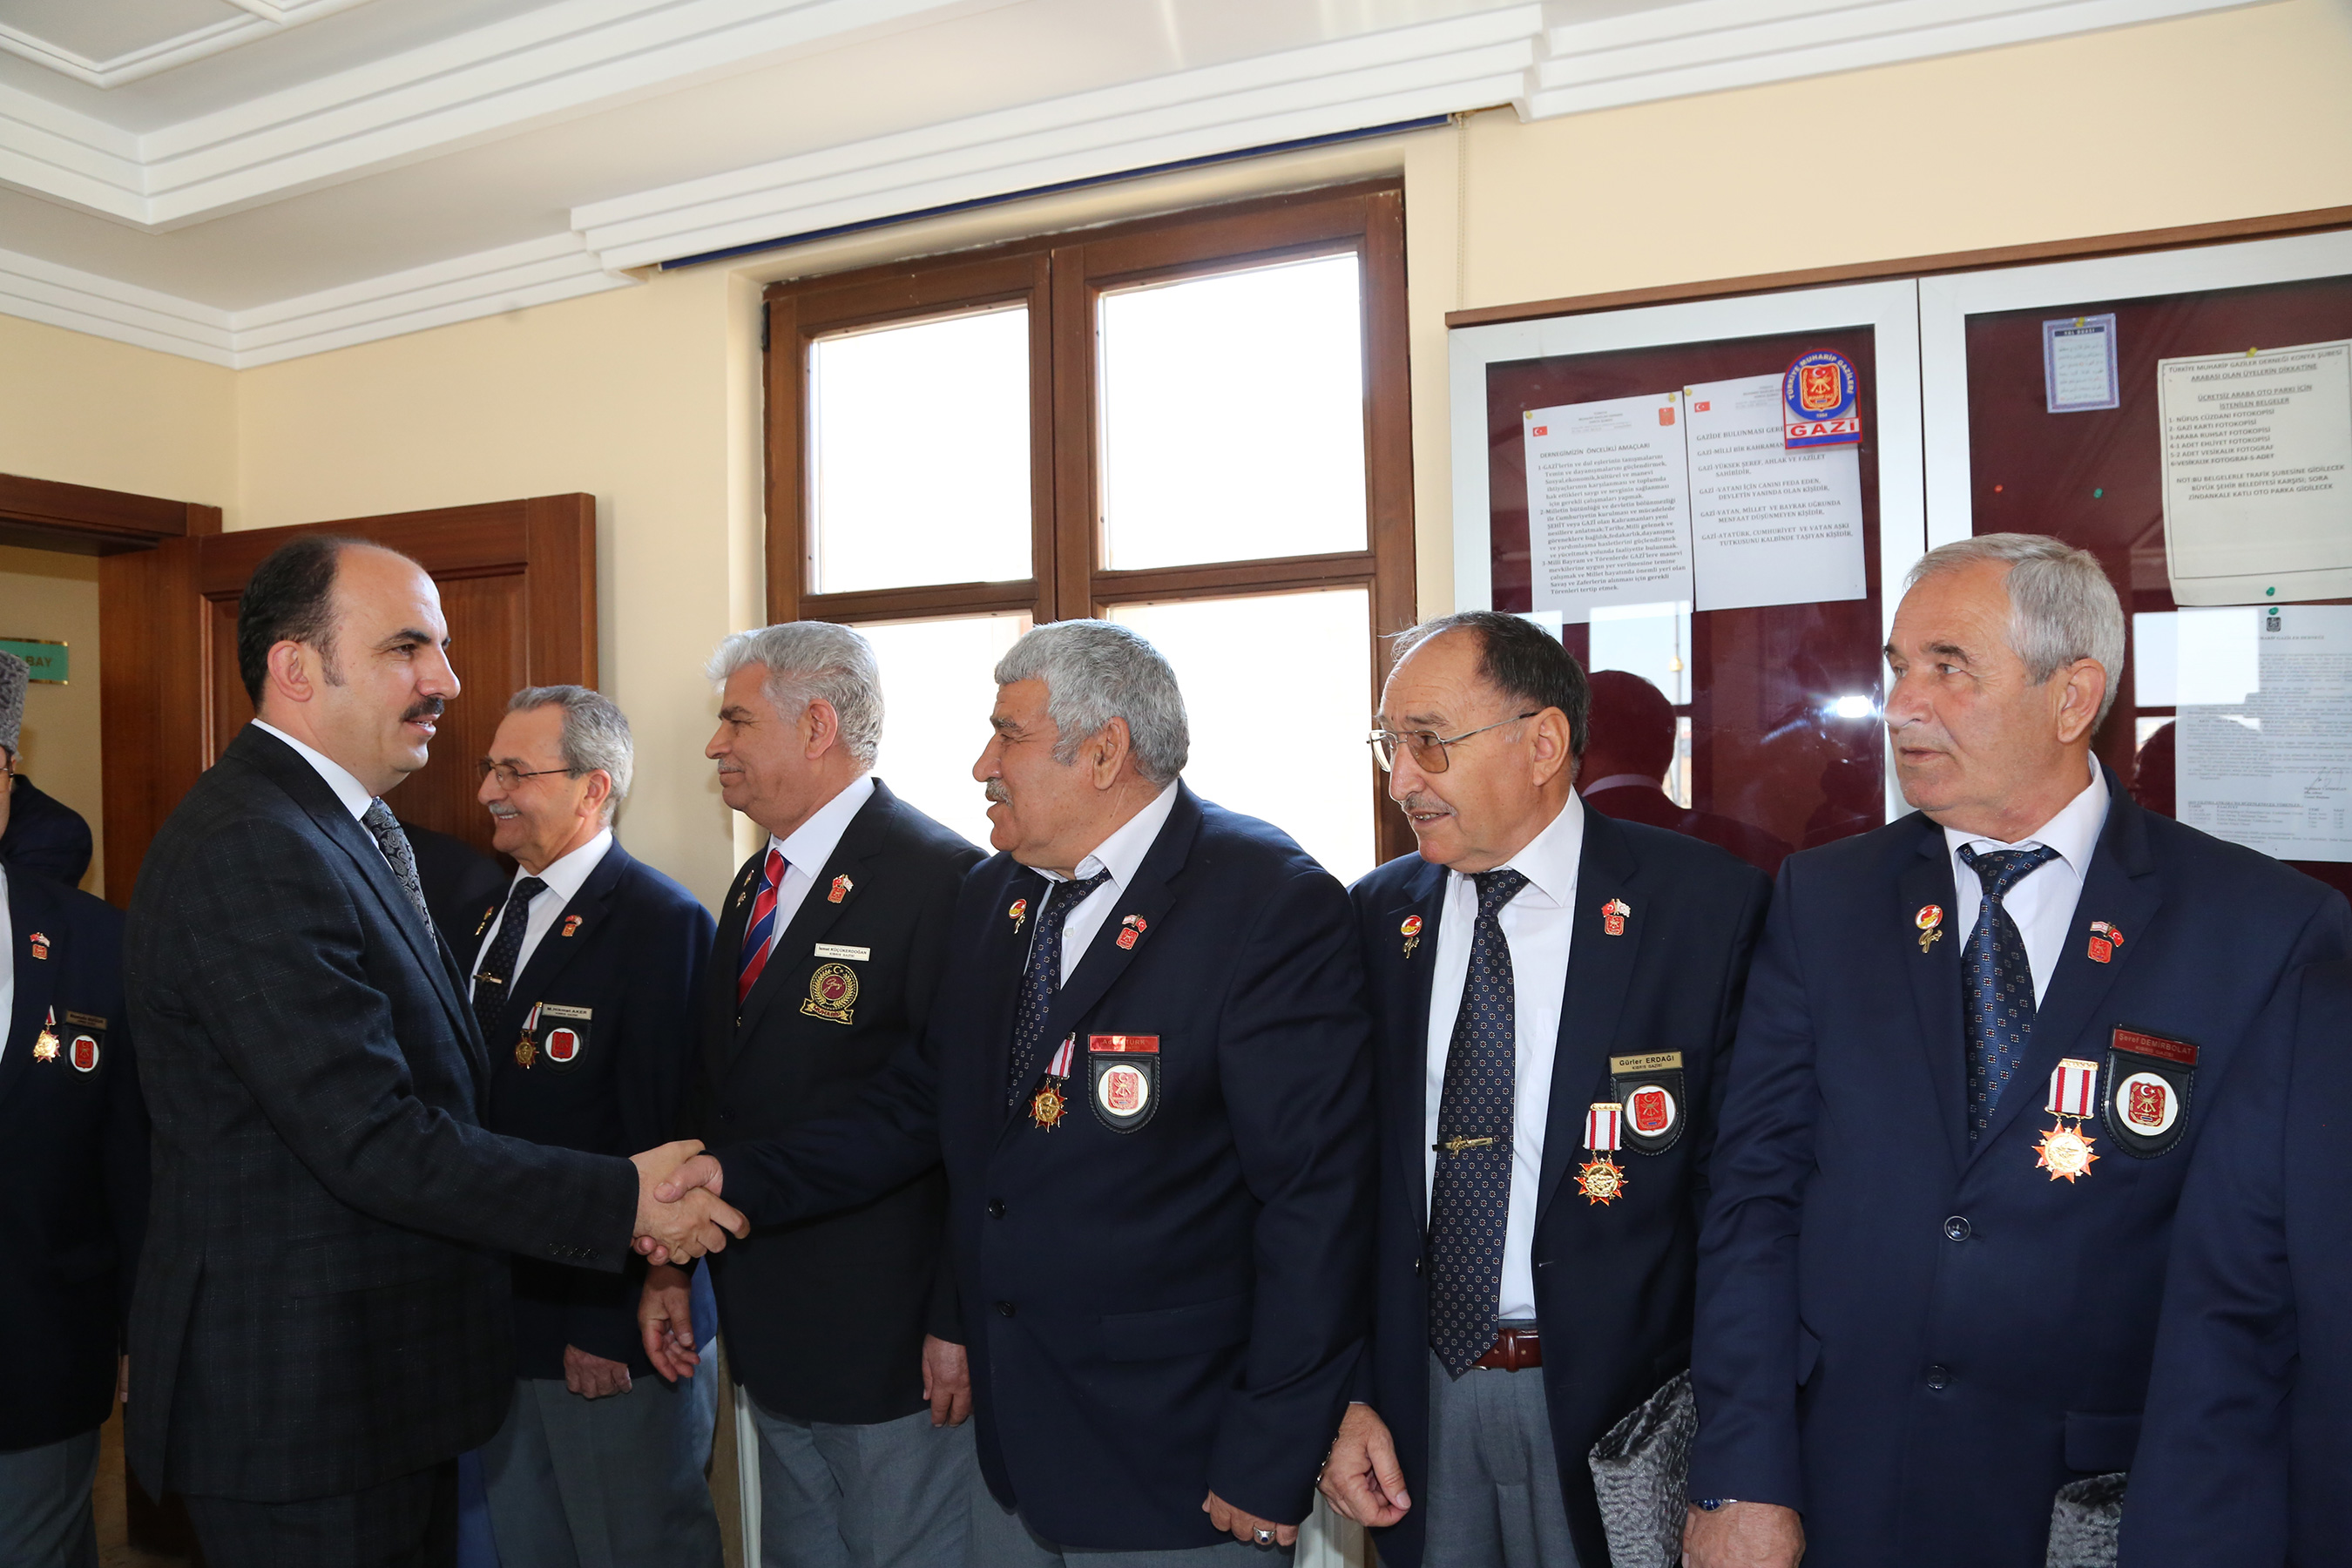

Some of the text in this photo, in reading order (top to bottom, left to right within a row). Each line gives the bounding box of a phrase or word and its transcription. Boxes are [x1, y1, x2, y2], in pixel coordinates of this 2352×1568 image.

[2168, 348, 2342, 374] TÜRKİYE MUHARİP GAZİLER DERNEĞİ KONYA ŞUBESİ
[1786, 363, 1801, 401] TÜRKİYE
[1799, 353, 1838, 368] MUHARİP
[1836, 359, 1855, 395] GAZİLERİ
[2190, 373, 2220, 382] ARABASI
[2242, 367, 2277, 377] ÜYELERİN
[2278, 362, 2317, 374] DİKKATİNE
[2197, 392, 2231, 402] ÜCRETSİZ
[2230, 389, 2255, 399] ARABA
[2255, 388, 2273, 396] OTO
[2273, 386, 2295, 395] PARKI
[2219, 396, 2289, 410] İSTENİLEN BELGELER
[2175, 414, 2200, 423] NÜFUS
[2200, 412, 2232, 421] CÜZDANI
[2232, 408, 2274, 418] FOTOKOPİSİ
[1790, 420, 1855, 437] GAZİ
[2214, 418, 2257, 429] FOTOKOPİSİ
[1696, 431, 1720, 441] GAZİDE
[1722, 428, 1765, 438] BULUNMASI
[2228, 426, 2271, 436] FOTOKOPİSİ
[1617, 442, 1650, 452] AMAÇLARI
[2200, 438, 2227, 448] EHLİYET
[2228, 435, 2270, 445] FOTOKOPİSİ
[2200, 447, 2234, 456] VESİKALIK
[1764, 456, 1788, 465] AHLAK
[1798, 453, 1825, 462] FAZİLET
[2203, 473, 2243, 482] BELGELERLE
[2271, 467, 2305, 477] ŞUBESİNE
[2307, 463, 2344, 473] GİDİLECEK
[1699, 486, 1714, 495] GAZİ
[1742, 483, 1757, 491] İÇİN
[2215, 482, 2236, 490] ŞEHİR
[2237, 478, 2276, 488] BELEDİYESİ
[1718, 490, 1751, 500] DEVLETİN
[1751, 489, 1782, 497] YANINDA
[2188, 491, 2230, 501] ZİNDANKALE
[2295, 483, 2333, 492] GİDİLECEK
[1779, 502, 1807, 510] BAYRAK
[1808, 498, 1841, 508] UĞRUNDA
[1555, 511, 1597, 522] Cumhuriyetin
[1597, 509, 1629, 517] kurulması
[1638, 504, 1675, 514] mücadelede
[1718, 515, 1749, 524] MENFAAT
[1750, 510, 1796, 521] DÜŞÜNMEYEN
[1752, 526, 1796, 536] CUMHURİYET
[1719, 537, 1760, 546] TUTKUSUNU
[1761, 534, 1794, 543] KALBİNDE
[1795, 531, 1825, 541] TAŞIYAN
[1561, 557, 1585, 565] Bayram
[1594, 553, 1629, 562] Törenlerde
[1548, 564, 1585, 573] mevkilerine
[1616, 559, 1653, 568] verilmesine
[1550, 572, 1577, 581] çalışmak
[1604, 568, 1635, 577] hayatında
[1646, 572, 1670, 582] gerekli
[1551, 586, 1579, 595] Törenleri
[24, 655, 52, 668] BAY
[2119, 1033, 2193, 1055] Şeref DEMİRBOLAT
[1646, 1055, 1674, 1064] ERDAĞI
